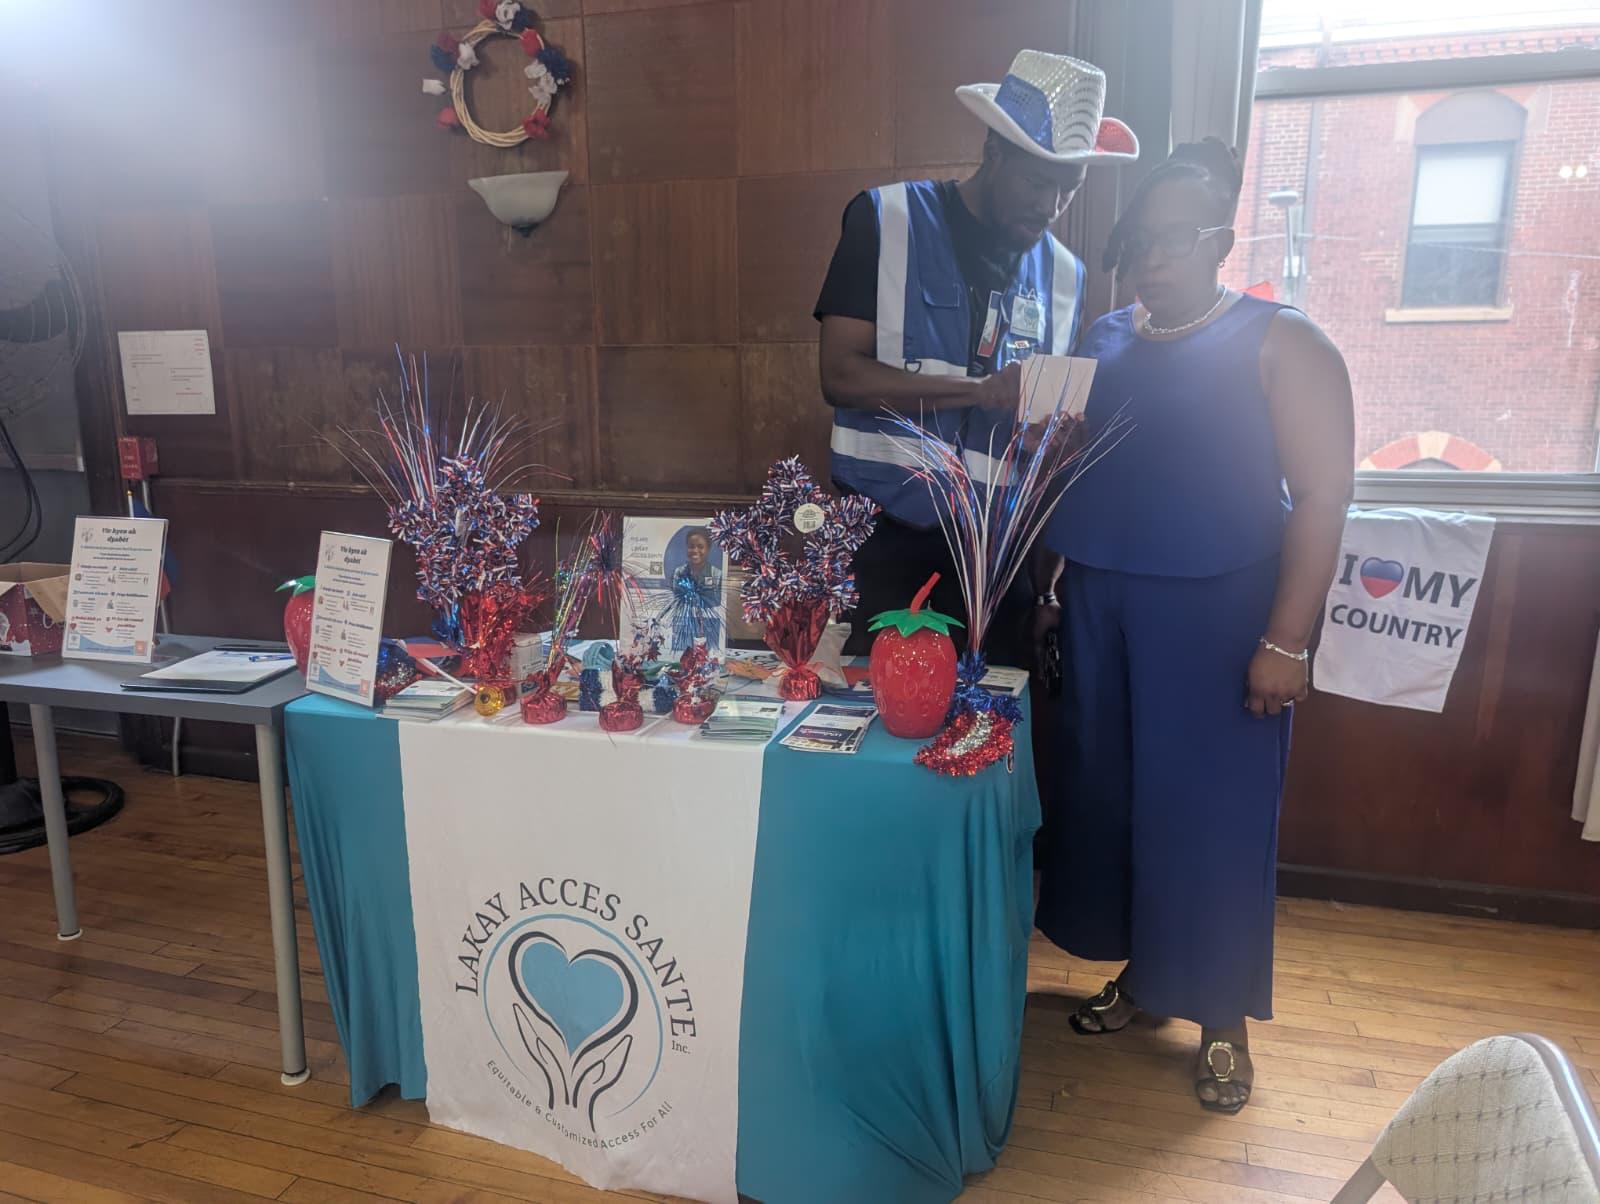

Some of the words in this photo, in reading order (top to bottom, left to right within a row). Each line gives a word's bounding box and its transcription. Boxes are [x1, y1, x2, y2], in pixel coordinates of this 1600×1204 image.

[1339, 554, 1359, 586] I
[1402, 566, 1478, 609] MY
[1330, 604, 1464, 649] COUNTRY
[455, 892, 511, 996] LAKAY
[519, 877, 622, 922] ACCES
[624, 914, 697, 1038] SANTE
[671, 1040, 691, 1055] Inc.
[486, 1060, 533, 1108] Equitable
[545, 1112, 599, 1149] Customized
[600, 1128, 641, 1150] Access
[641, 1117, 659, 1135] For
[659, 1100, 673, 1120] All
